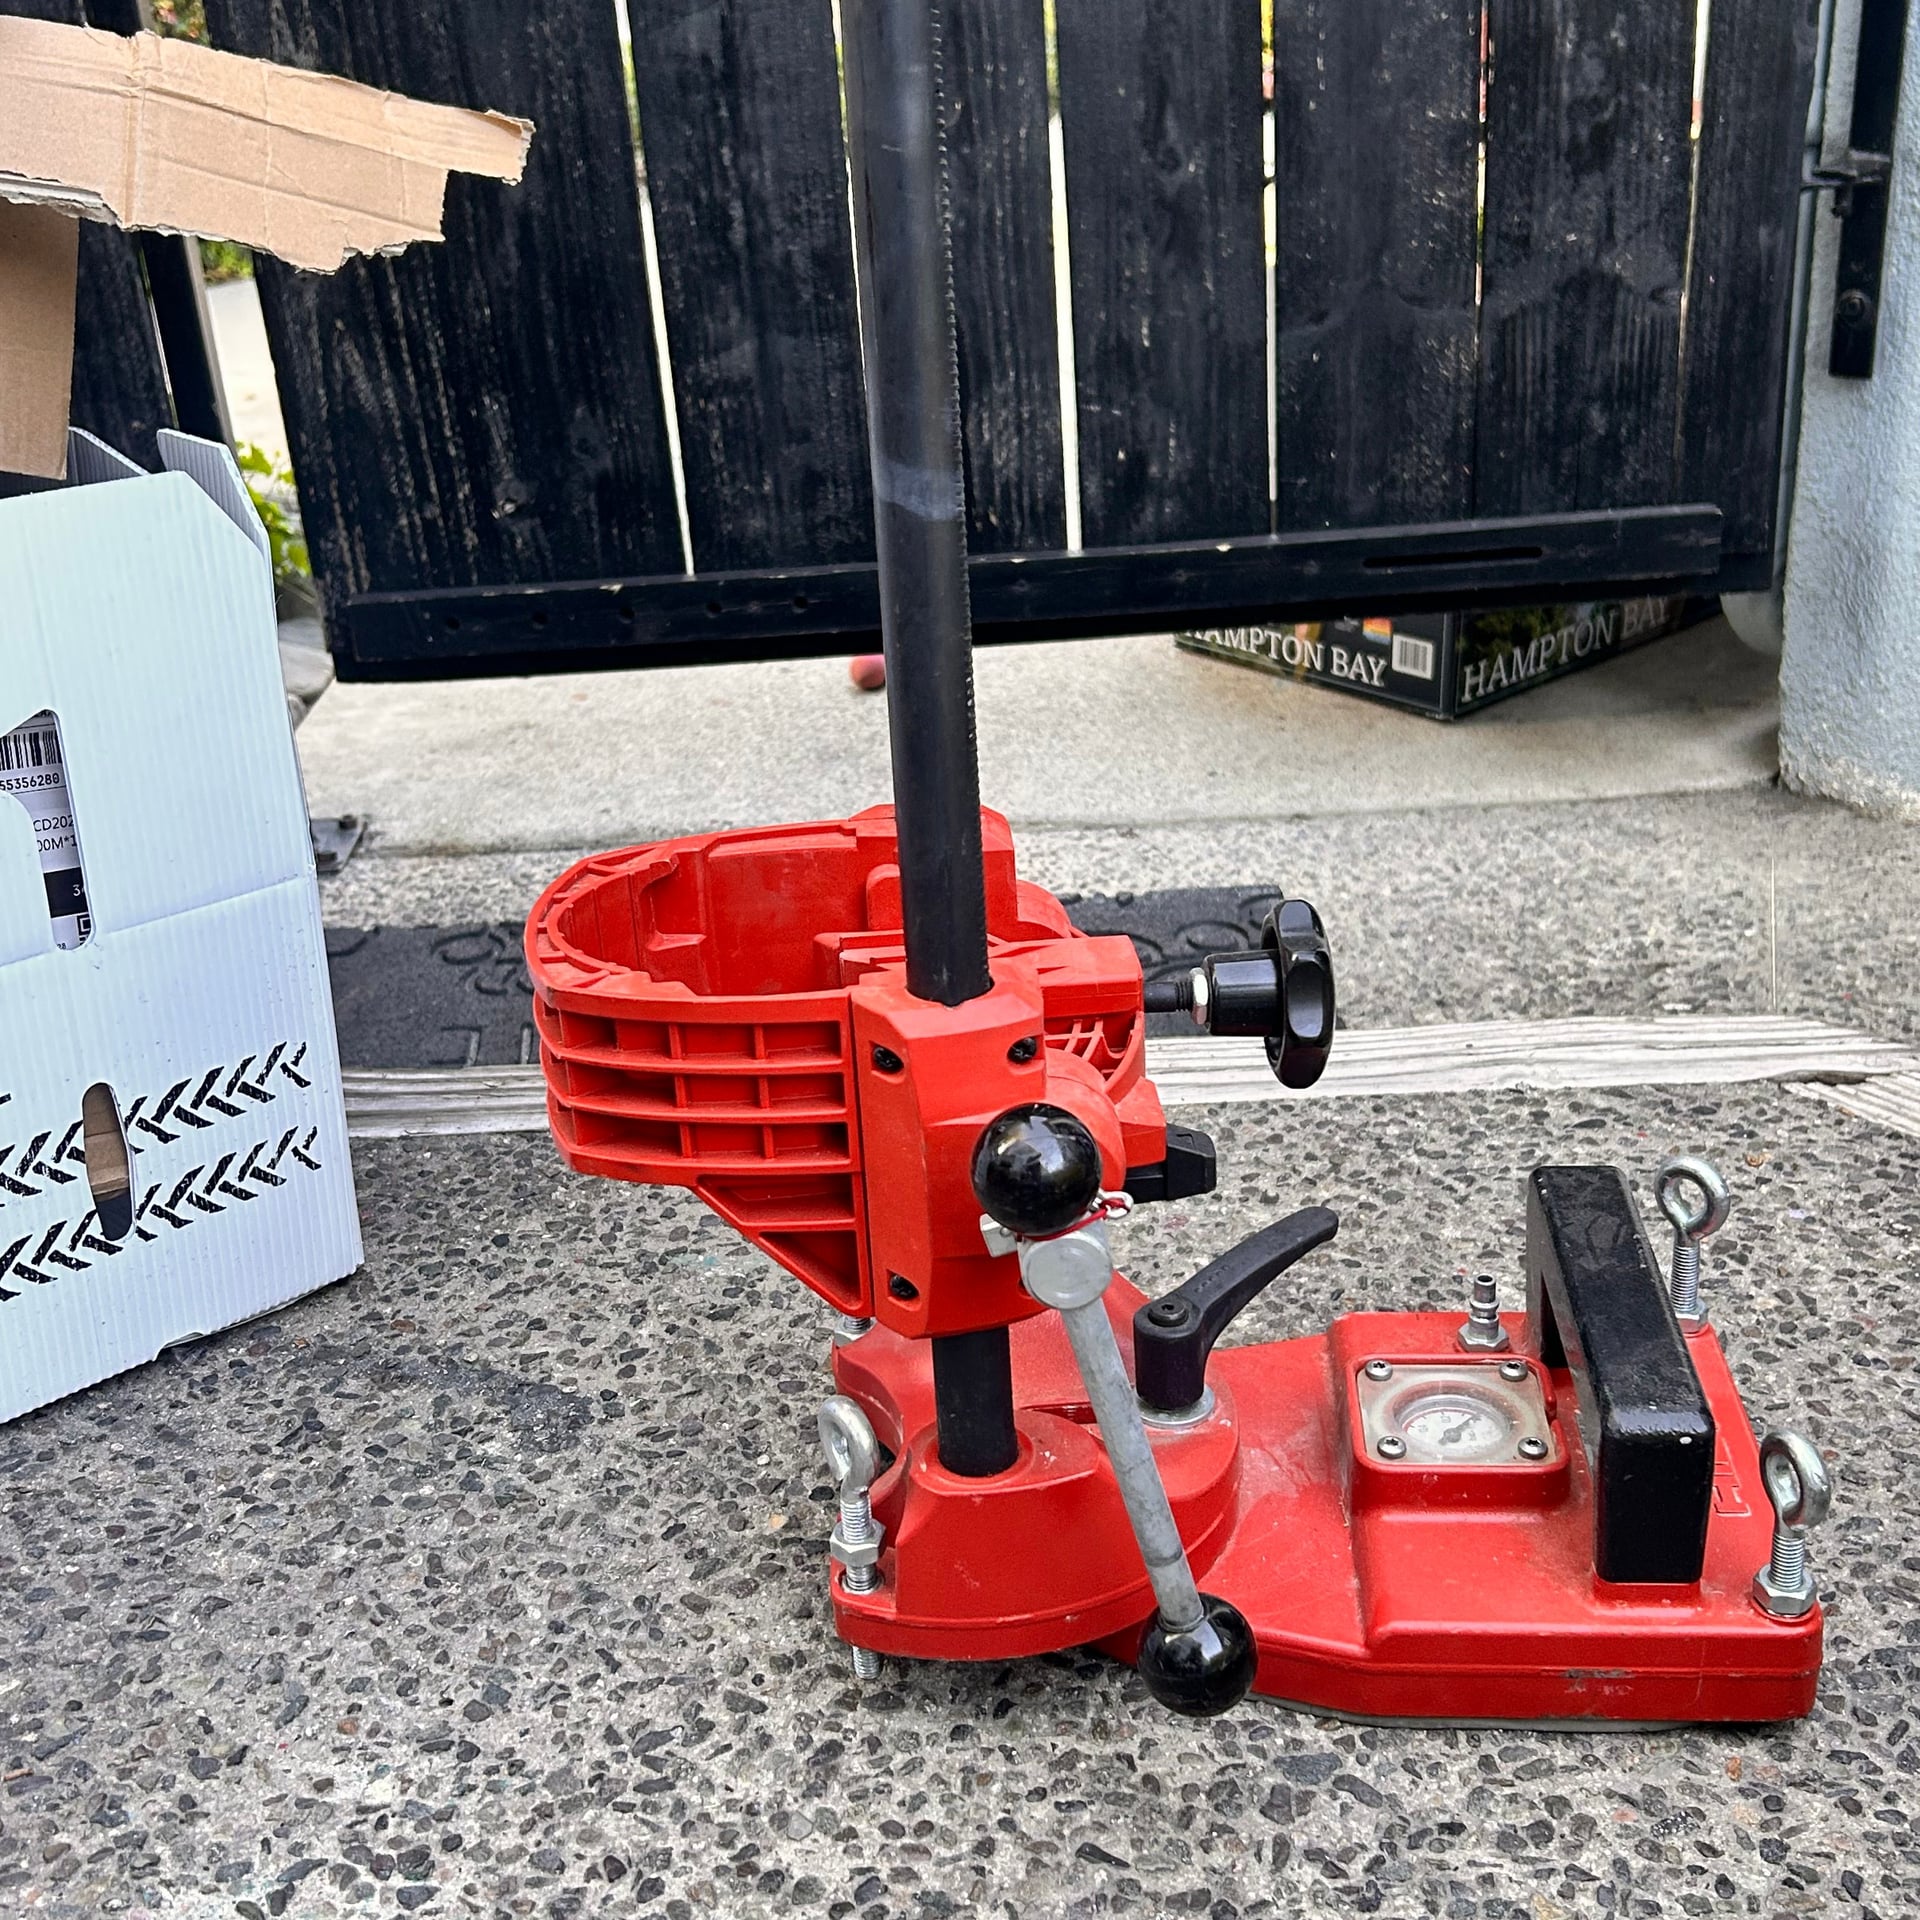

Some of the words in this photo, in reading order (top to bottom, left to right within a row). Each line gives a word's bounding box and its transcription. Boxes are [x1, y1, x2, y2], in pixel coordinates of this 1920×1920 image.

[1331, 646, 1388, 687] BAY
[1461, 610, 1620, 702] HAMPTON
[1621, 593, 1670, 638] BAY
